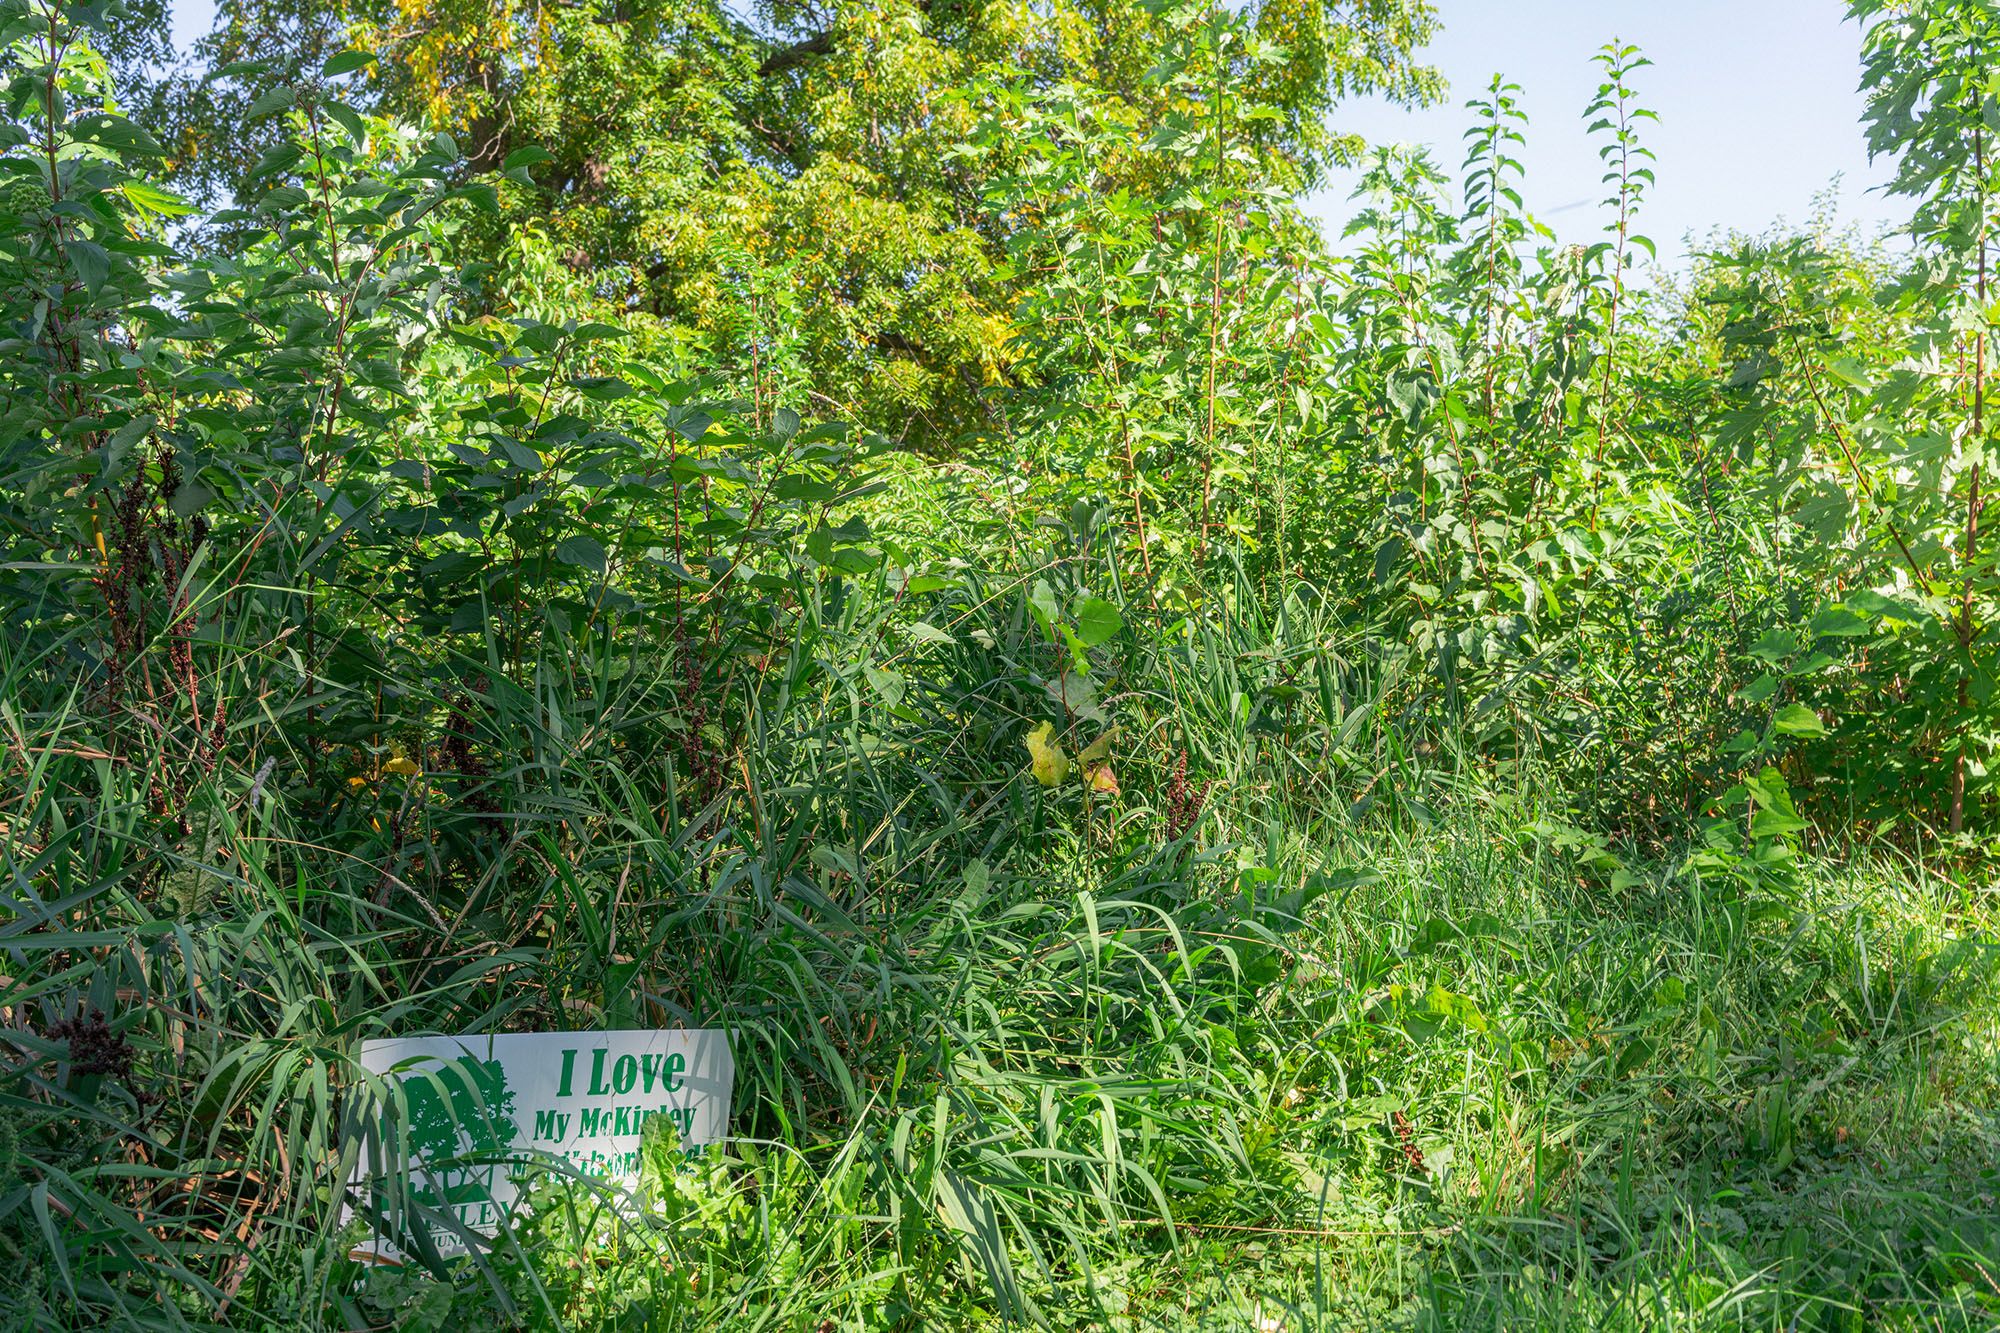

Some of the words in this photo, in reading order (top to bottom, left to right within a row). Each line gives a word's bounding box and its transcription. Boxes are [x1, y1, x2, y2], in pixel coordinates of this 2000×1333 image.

[556, 1049, 577, 1096] I
[587, 1049, 686, 1096] Love
[533, 1110, 571, 1143] My
[578, 1105, 697, 1139] McKiey
